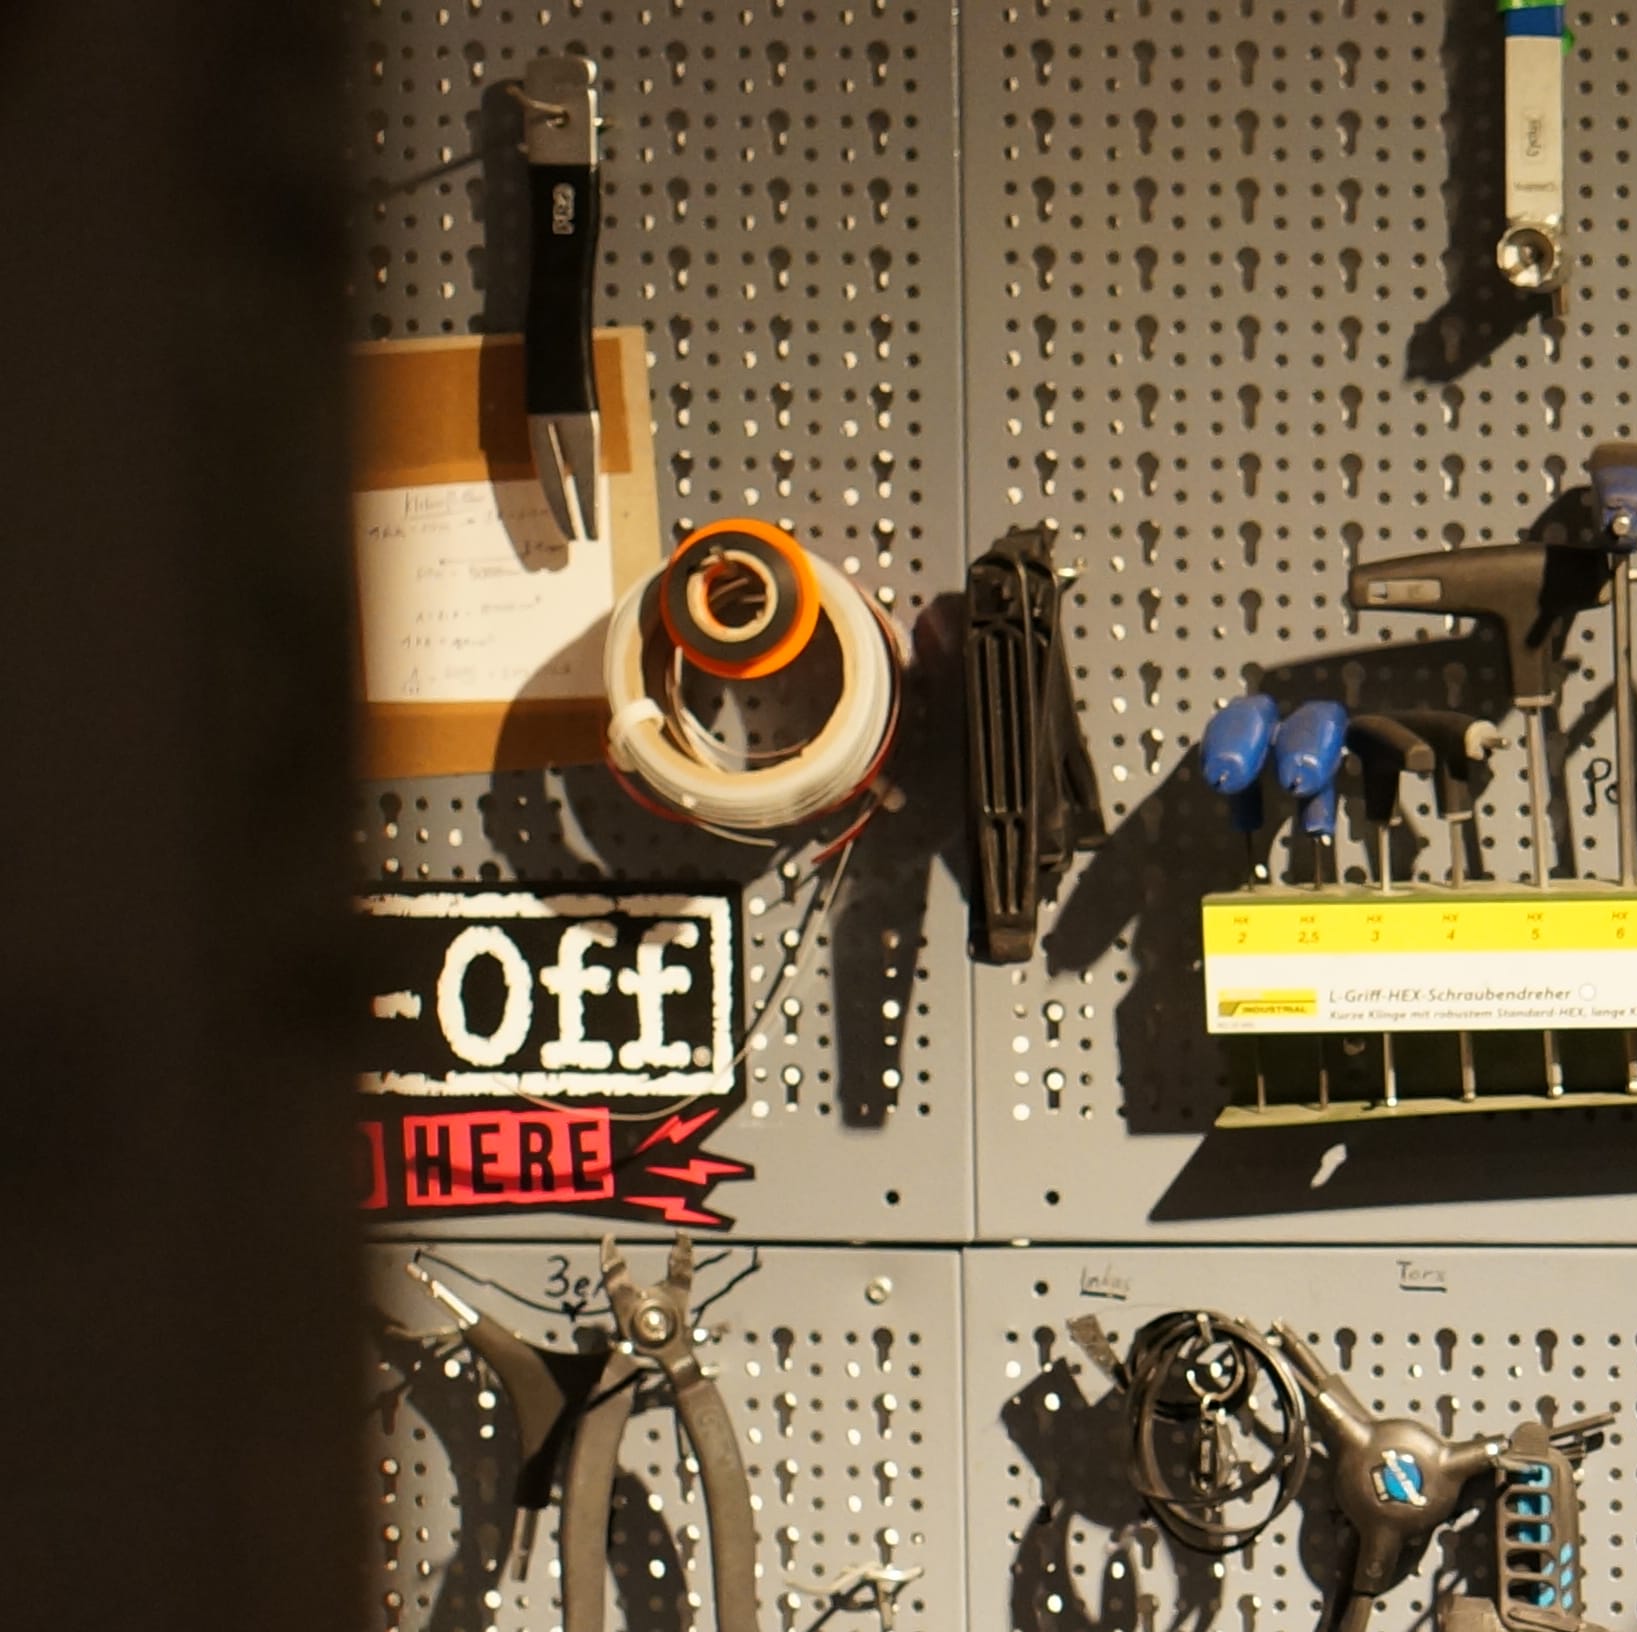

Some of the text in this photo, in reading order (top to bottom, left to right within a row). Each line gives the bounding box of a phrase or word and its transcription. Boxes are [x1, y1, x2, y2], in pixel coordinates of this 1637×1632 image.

[1238, 932, 1247, 944] 2
[1371, 931, 1380, 942] 3
[1446, 930, 1456, 941] 4
[1531, 929, 1540, 940] 5
[1616, 928, 1626, 939] 6
[1368, 1010, 1406, 1021] Klinge
[413, 1120, 604, 1197] HERE
